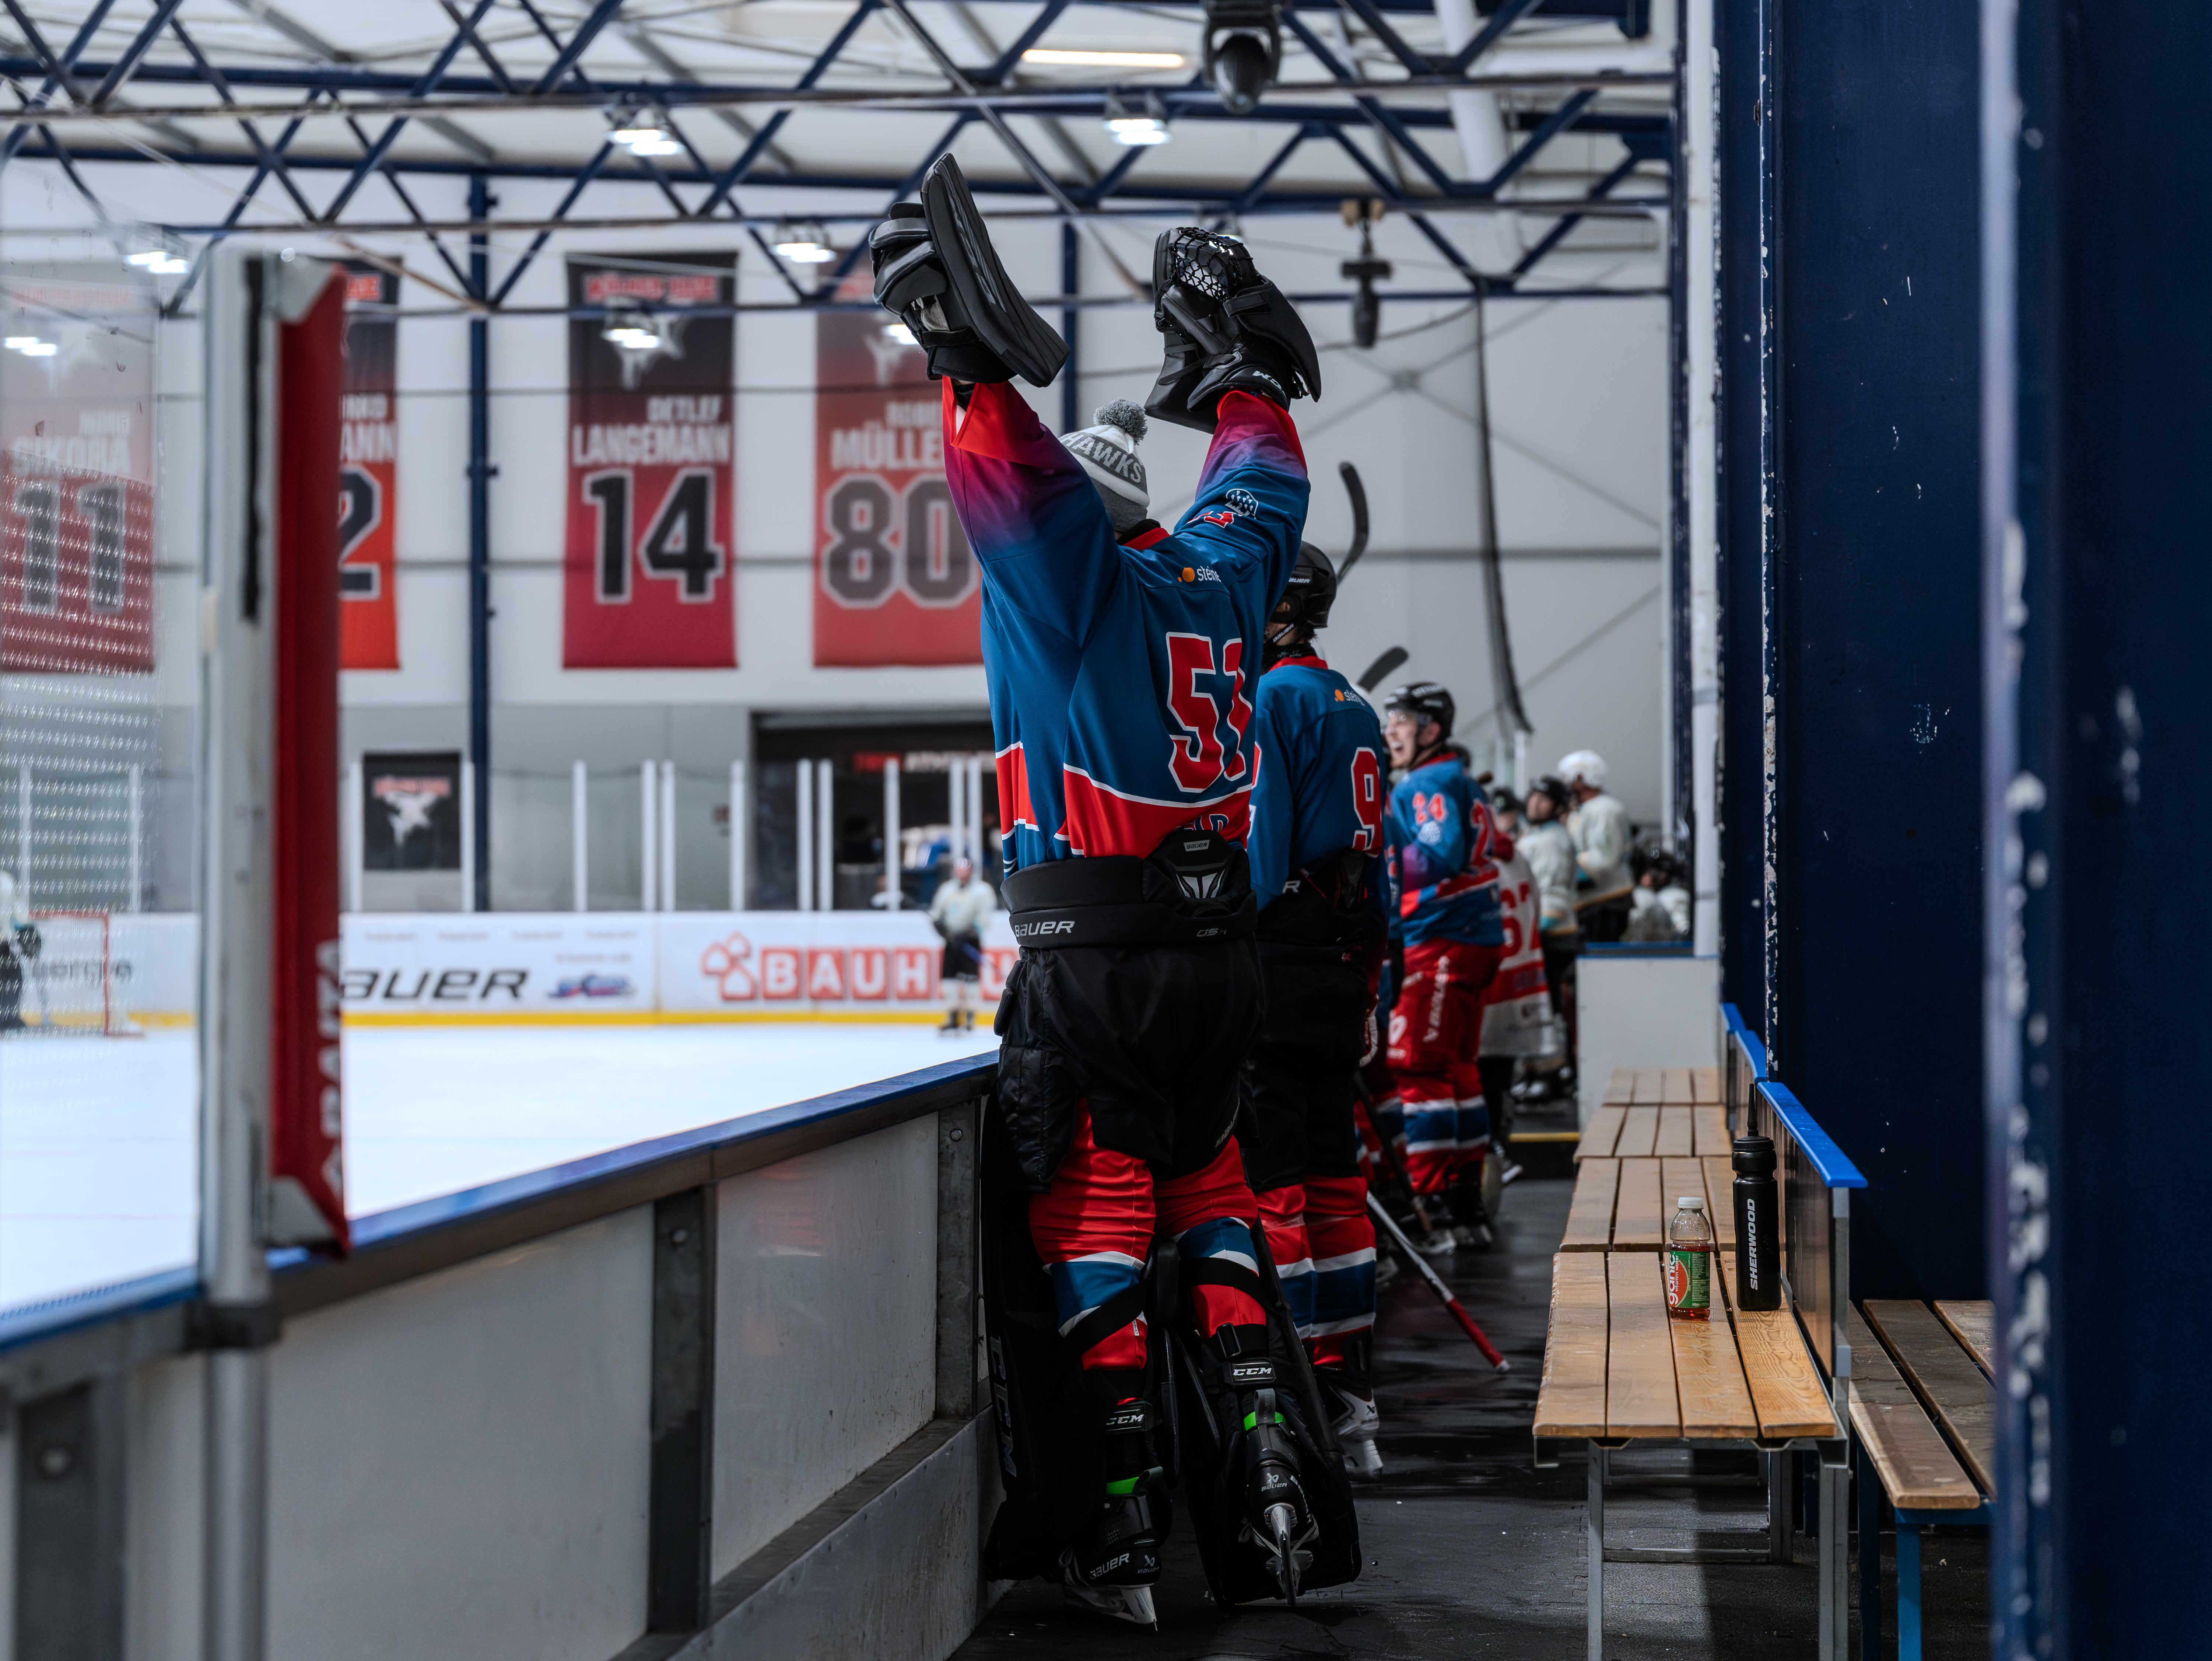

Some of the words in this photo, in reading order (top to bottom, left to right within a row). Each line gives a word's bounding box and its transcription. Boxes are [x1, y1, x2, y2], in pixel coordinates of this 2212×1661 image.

[573, 422, 730, 465] LANGEMANN
[831, 420, 944, 470] MÜLLE
[1060, 433, 1142, 483] HAWKS
[11, 481, 126, 613] 11
[582, 466, 725, 604] 14
[821, 472, 979, 609] 80
[1412, 791, 1448, 826] 24
[1015, 921, 1075, 937] BAUER
[341, 969, 530, 1001] AUER
[1747, 1199, 1758, 1290] SHERWOOD
[1233, 1367, 1272, 1376] CCM
[1261, 1482, 1287, 1492] BAUER
[1088, 1552, 1130, 1580] BAUER
